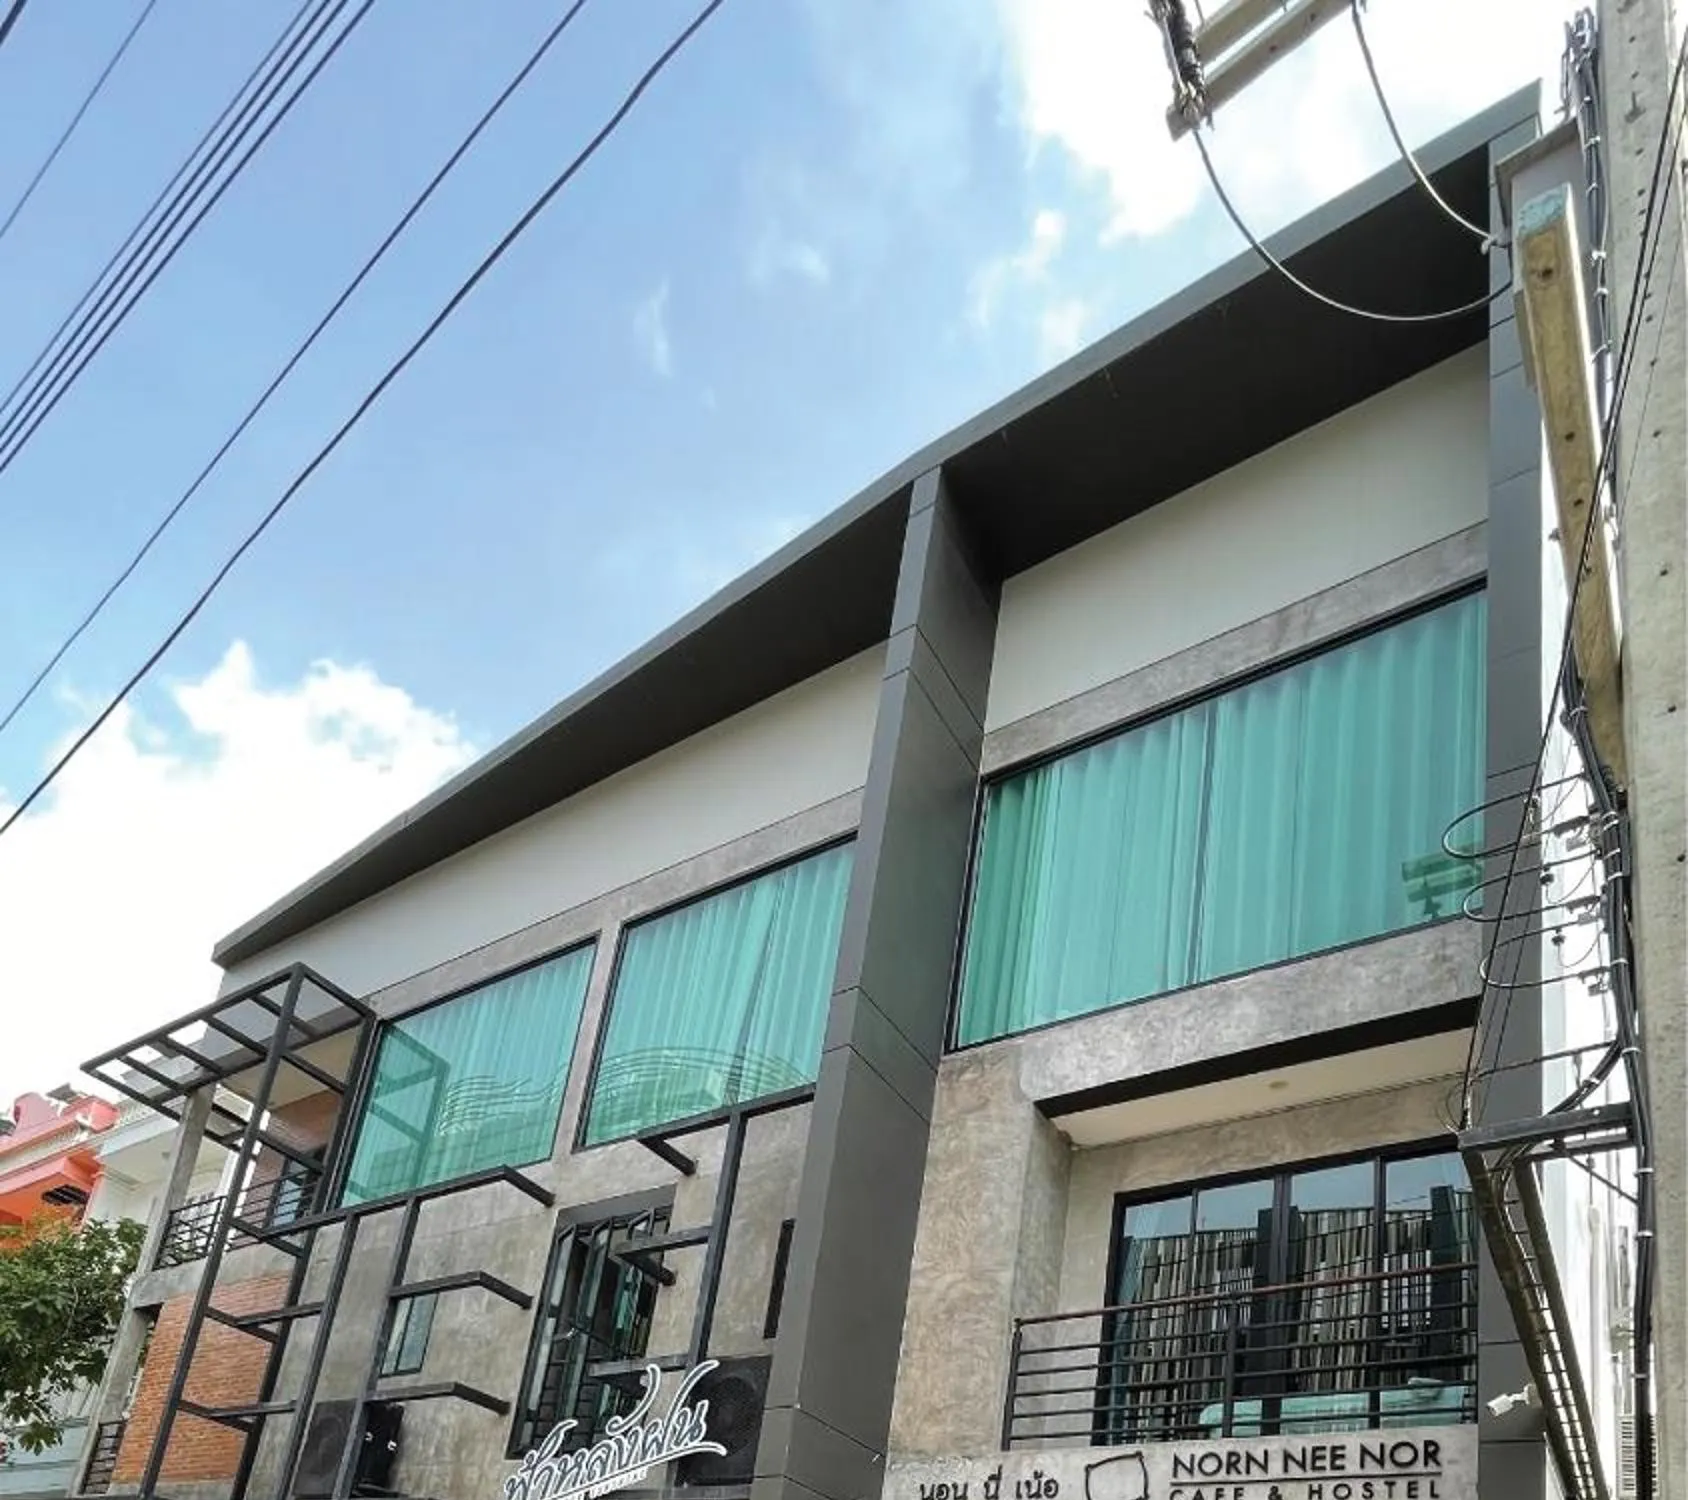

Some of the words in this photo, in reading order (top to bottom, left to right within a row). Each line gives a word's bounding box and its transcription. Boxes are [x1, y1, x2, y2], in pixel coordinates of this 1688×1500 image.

[1172, 1448, 1269, 1478] NORN
[1283, 1444, 1347, 1474] NEE
[1359, 1439, 1442, 1470] NOR
[919, 1480, 968, 1500] นอน
[983, 1463, 1004, 1500] นี่
[1015, 1469, 1060, 1500] เน้อ
